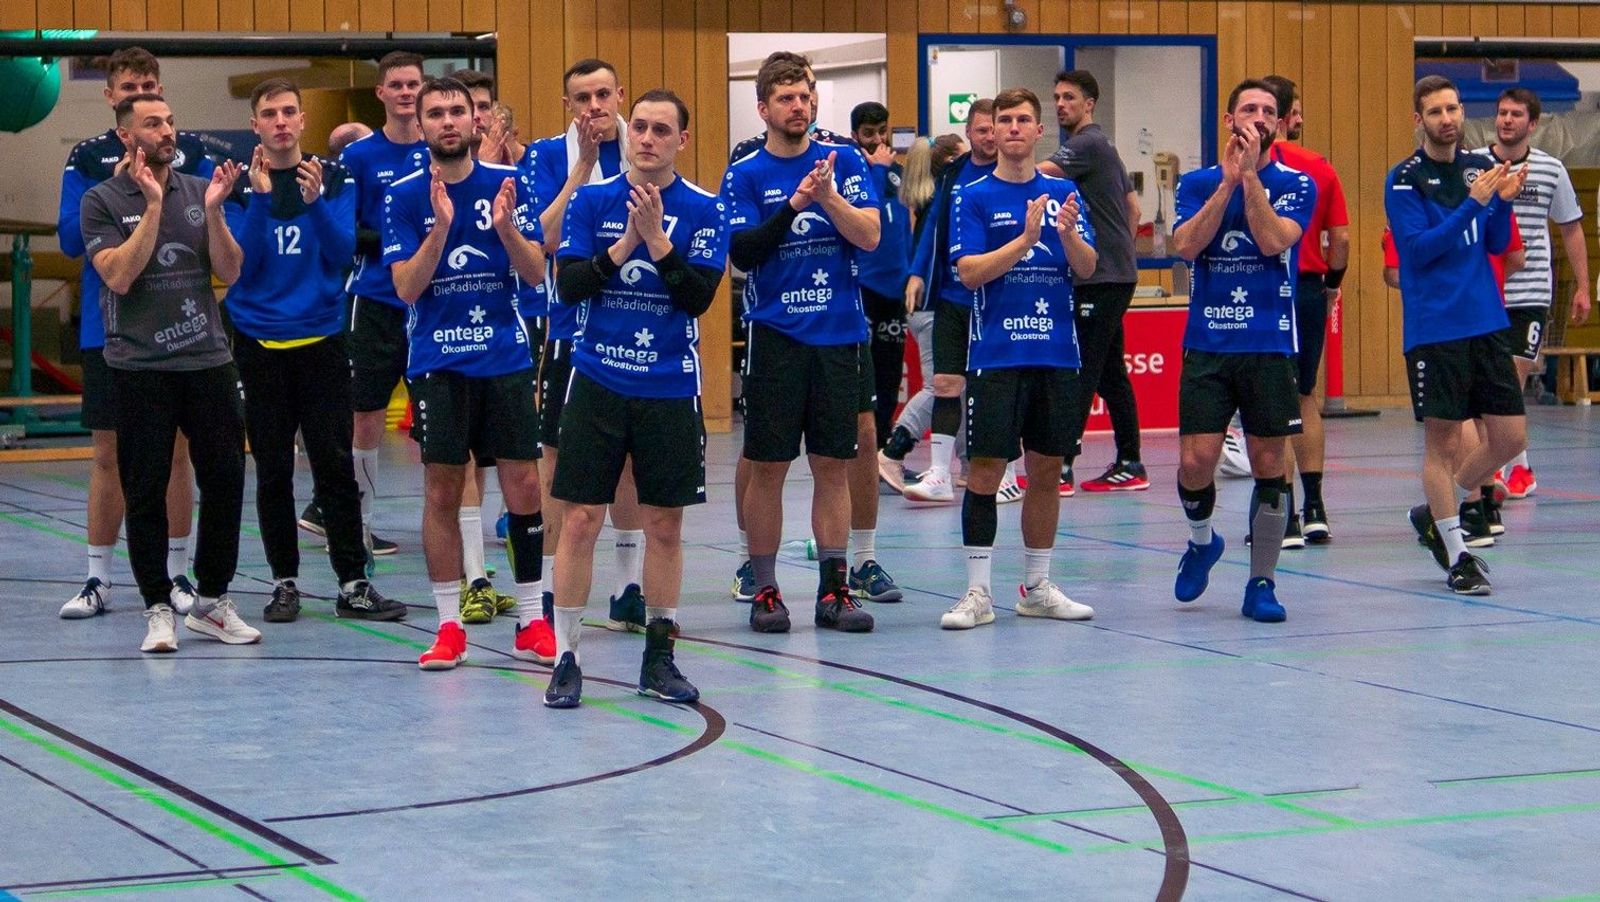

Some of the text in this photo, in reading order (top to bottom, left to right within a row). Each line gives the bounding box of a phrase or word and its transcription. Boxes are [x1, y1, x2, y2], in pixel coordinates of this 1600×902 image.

[122, 215, 141, 223] JAKO
[474, 199, 493, 230] 3
[602, 221, 624, 230] JAKO
[274, 225, 302, 255] 12
[433, 280, 504, 297] DieRadiologen
[781, 287, 832, 303] entega
[1204, 304, 1254, 320] entega
[154, 313, 208, 343] entega
[1003, 315, 1054, 332] entega
[1208, 320, 1248, 330] Ökostrom
[166, 331, 208, 352] Ökostrom
[433, 326, 494, 343] entega
[1010, 331, 1050, 341] Ökostrom
[1527, 321, 1541, 345] 6
[441, 343, 488, 354] Ökostrom
[595, 342, 658, 365] entega
[601, 357, 649, 373] Ökostrom
[1124, 353, 1164, 374] sse
